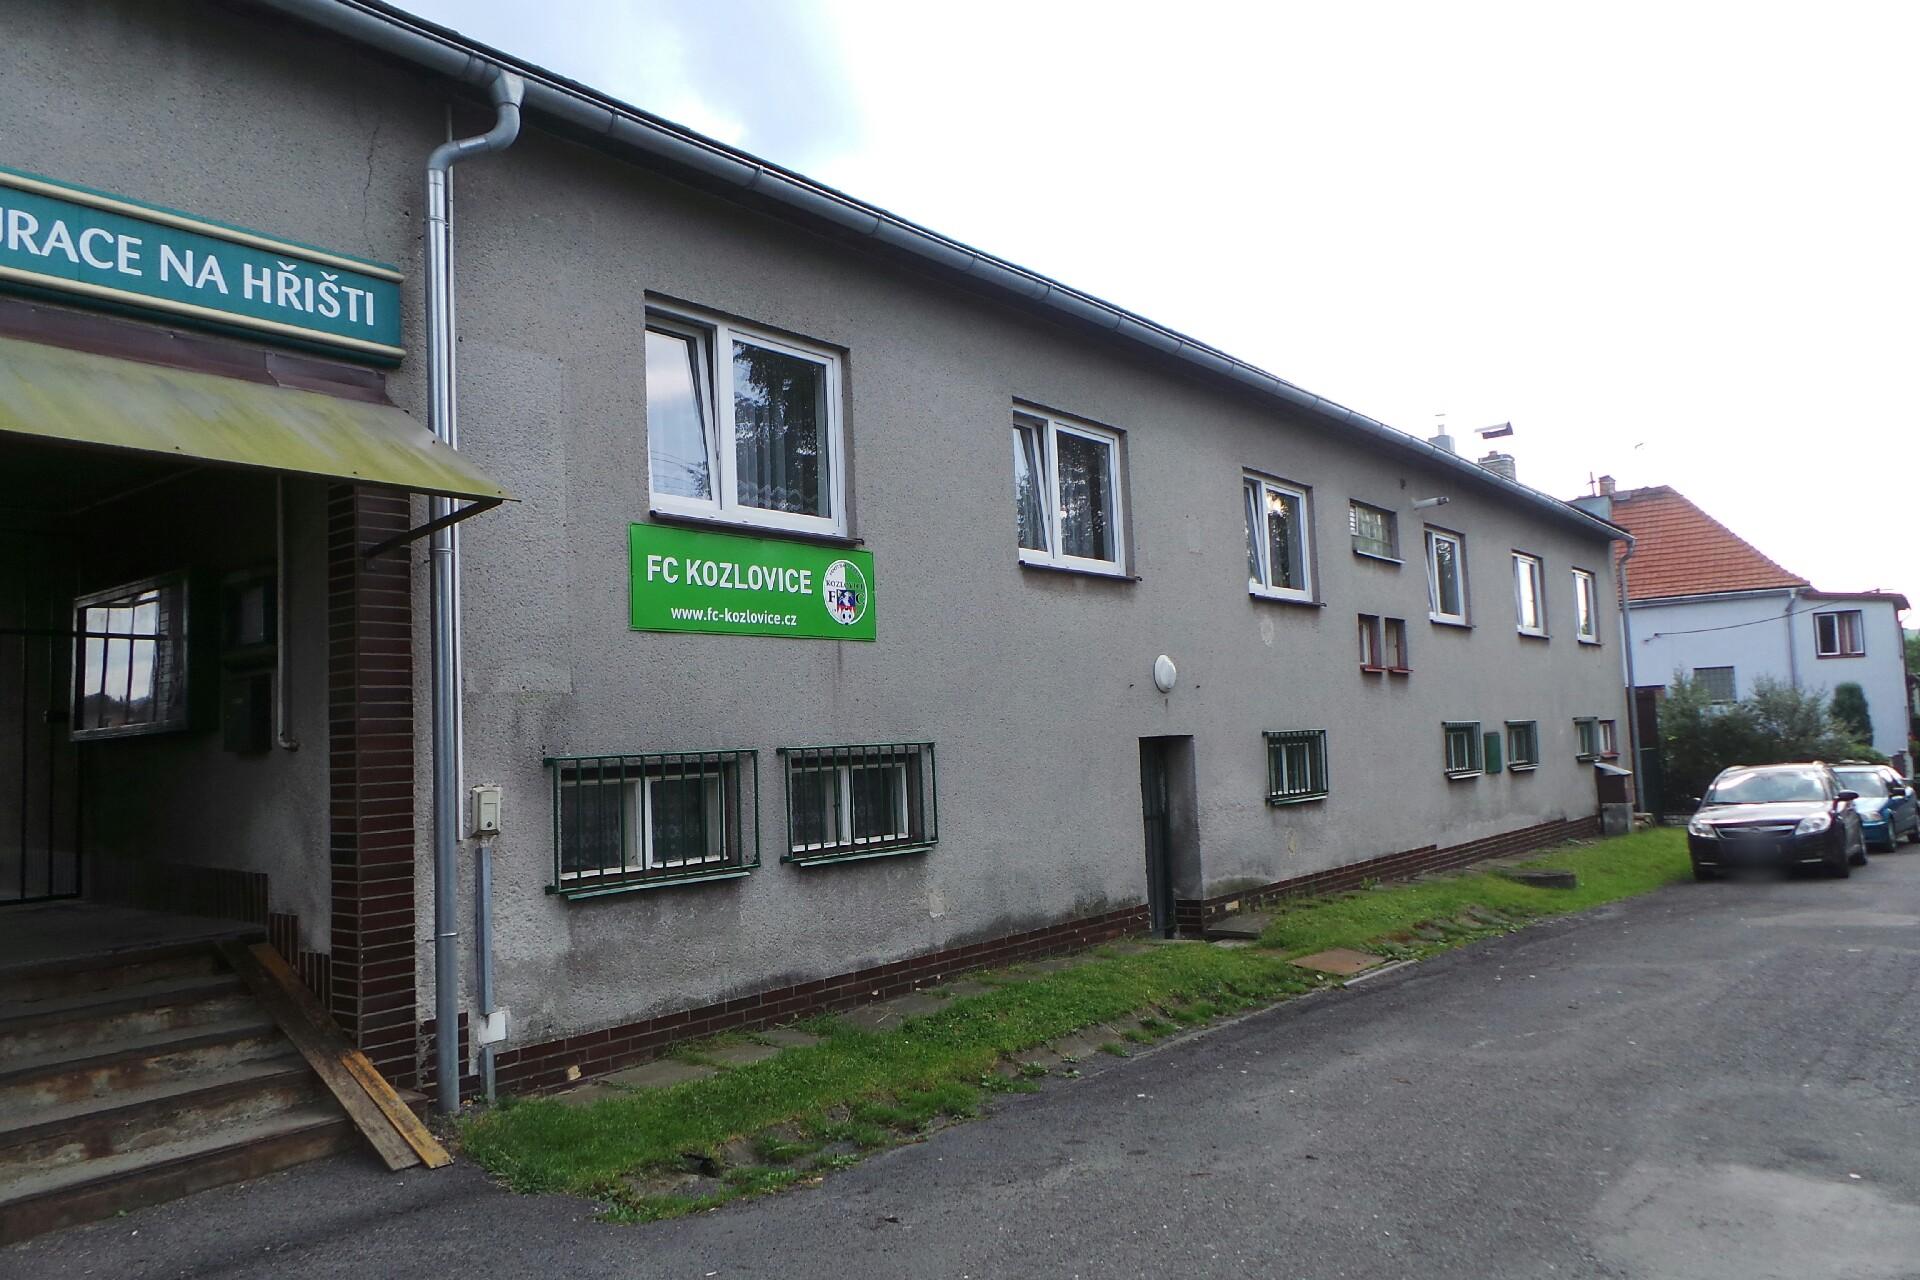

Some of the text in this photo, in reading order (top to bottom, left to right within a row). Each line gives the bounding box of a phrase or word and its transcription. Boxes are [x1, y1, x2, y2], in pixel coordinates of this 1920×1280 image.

[0, 207, 374, 326] RACE NA HŘIŠTI
[647, 554, 679, 584] FC
[686, 558, 813, 594] KOZLOVICE
[671, 606, 797, 626] www.fc-kozlovice.cz
